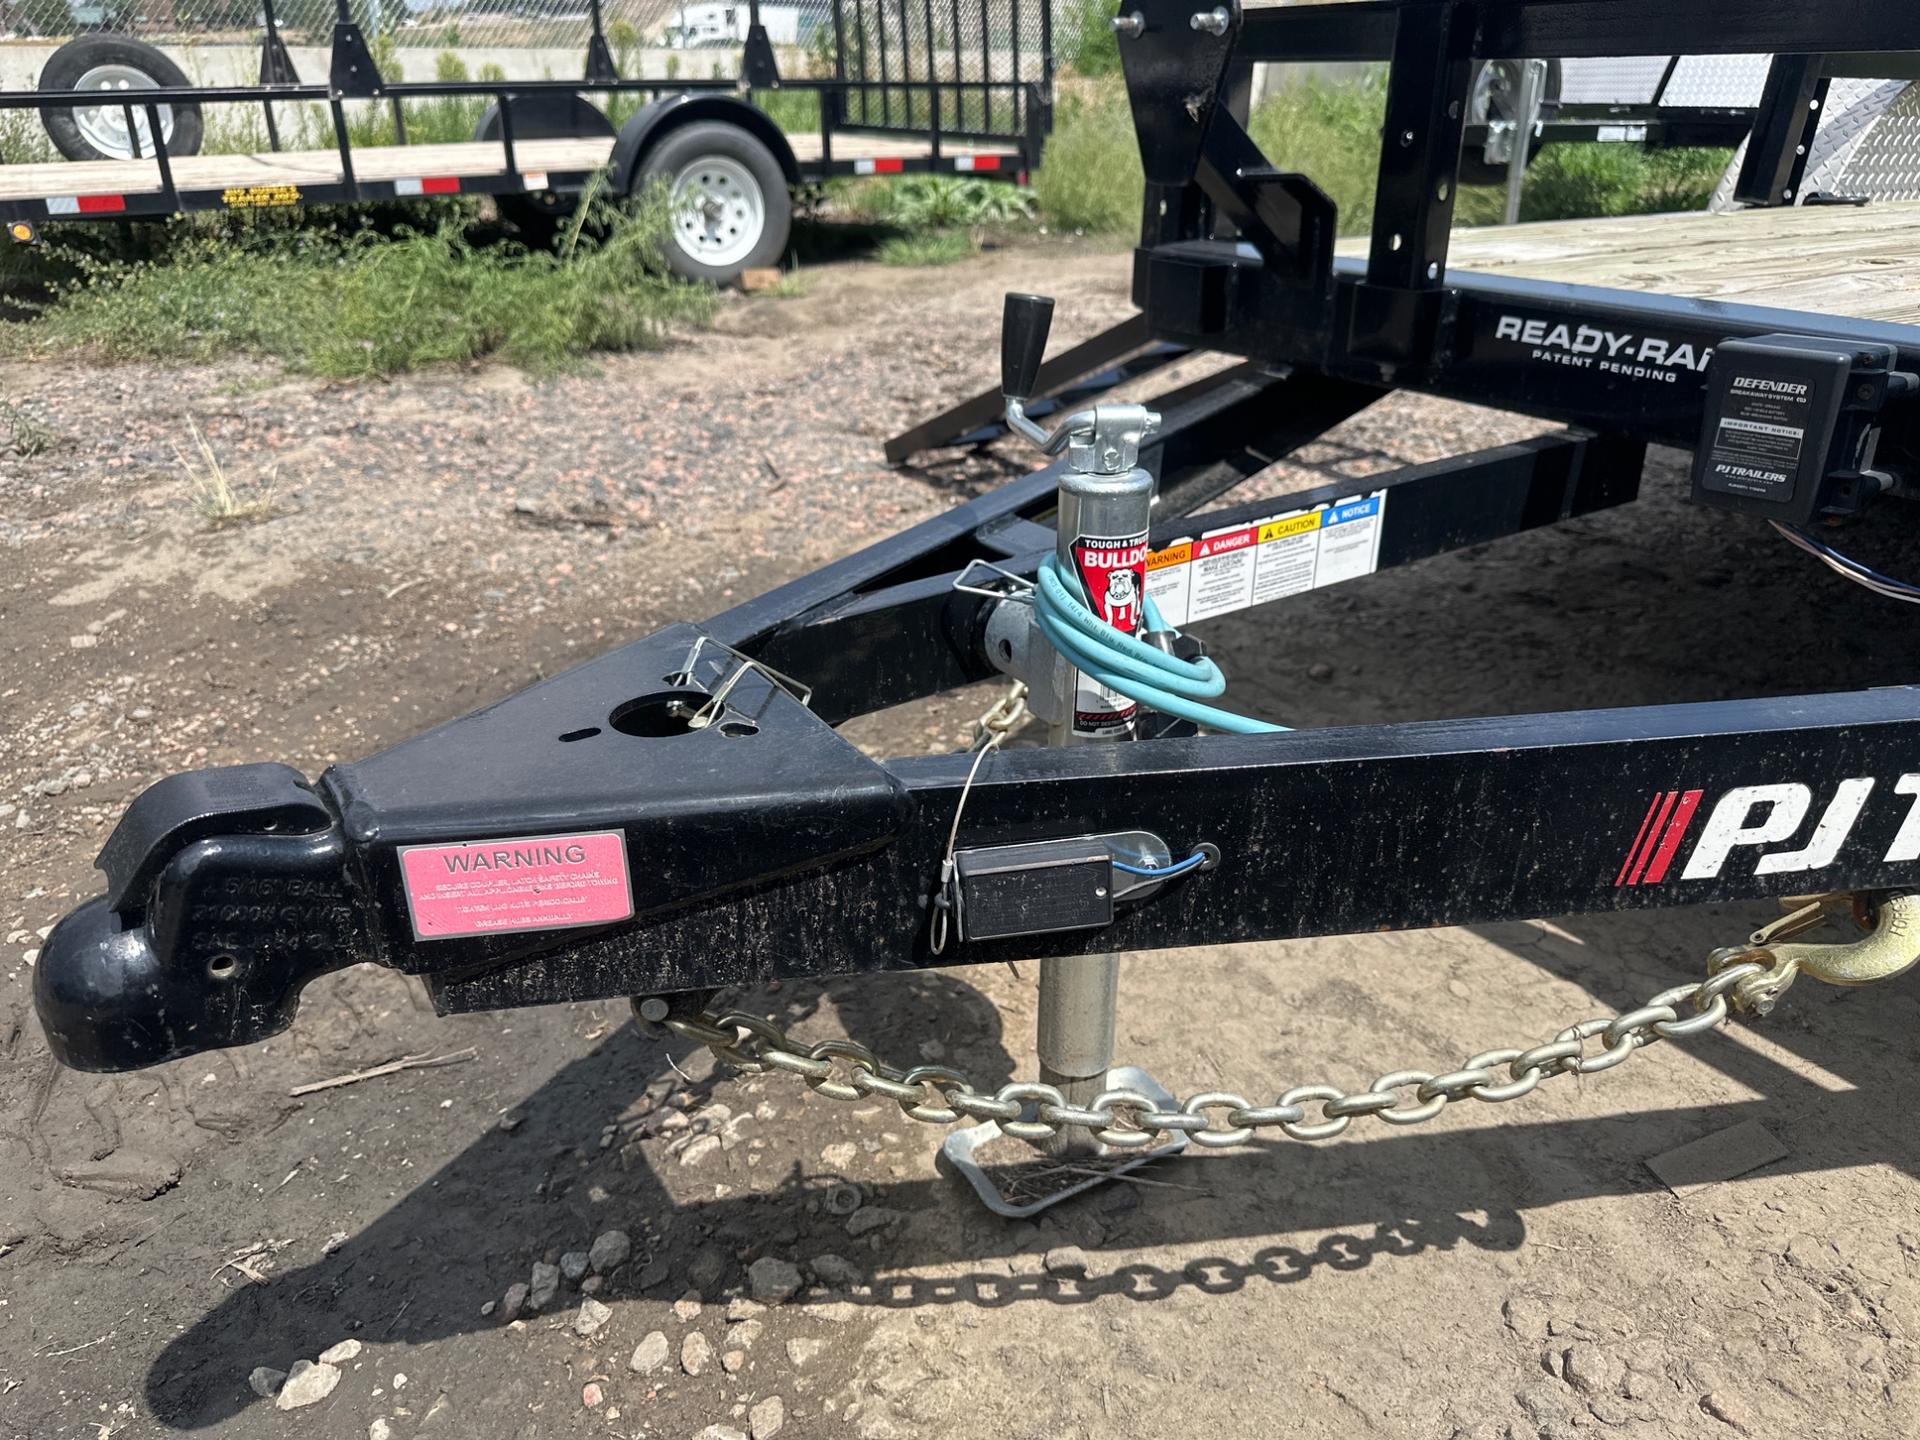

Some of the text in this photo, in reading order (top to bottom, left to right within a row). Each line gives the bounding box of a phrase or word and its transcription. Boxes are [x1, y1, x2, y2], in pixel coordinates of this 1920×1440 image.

[1532, 349, 1678, 383] PATENT PENDING
[1732, 377, 1808, 395] DEFENDER
[1768, 393, 1794, 402] SYSTEM
[1723, 420, 1768, 431] IMPORTANT
[1715, 463, 1731, 473] PJ
[1731, 465, 1788, 483] TRAILERS
[1341, 502, 1371, 520] NOTICE
[1277, 518, 1316, 536] CAUTION
[1084, 539, 1121, 550] TOUGH
[1121, 540, 1128, 548] &
[1213, 533, 1251, 552] DANGER
[1680, 776, 1876, 880] PJ
[442, 844, 587, 875] WARNING
[287, 878, 343, 898] BALL
